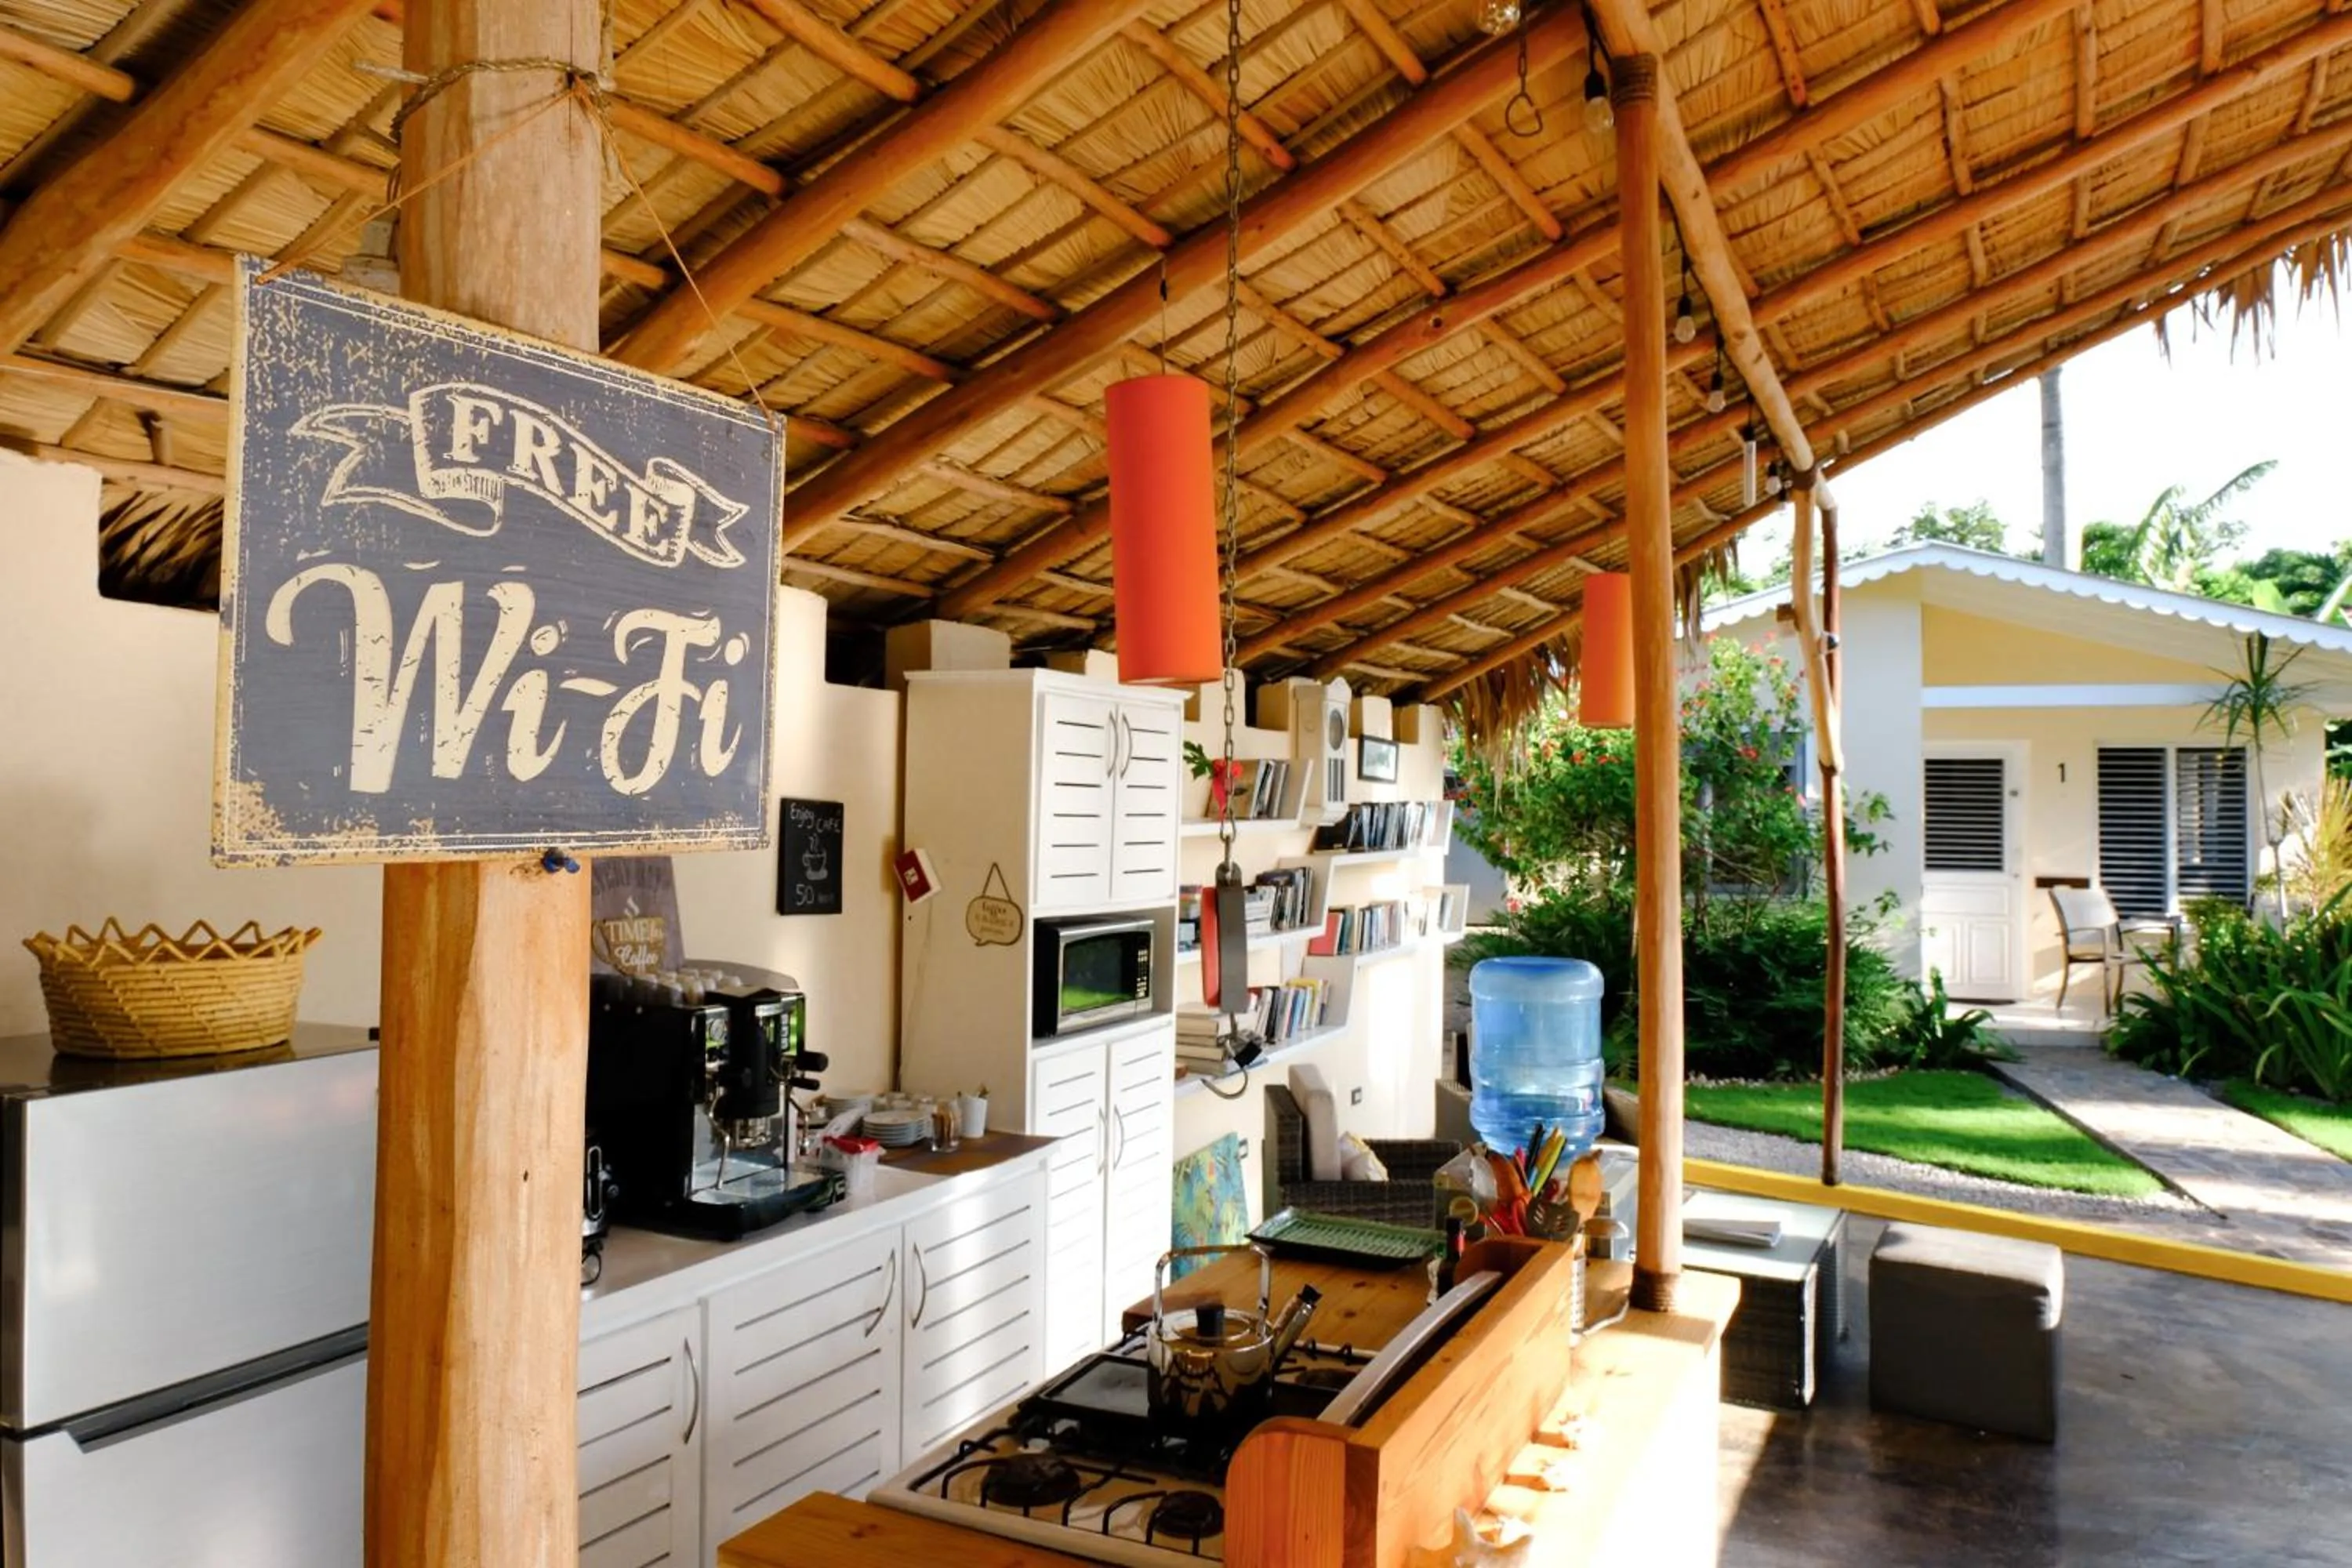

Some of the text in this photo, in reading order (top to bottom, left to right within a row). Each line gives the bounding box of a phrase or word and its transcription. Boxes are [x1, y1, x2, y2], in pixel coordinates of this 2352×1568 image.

[443, 394, 670, 557] FREE
[265, 562, 747, 795] Wi-Fi
[2057, 762, 2066, 783] 1
[789, 801, 815, 829] Enjoy
[795, 883, 815, 906] 50
[604, 919, 650, 943] TIME
[614, 943, 659, 974] Coffee
